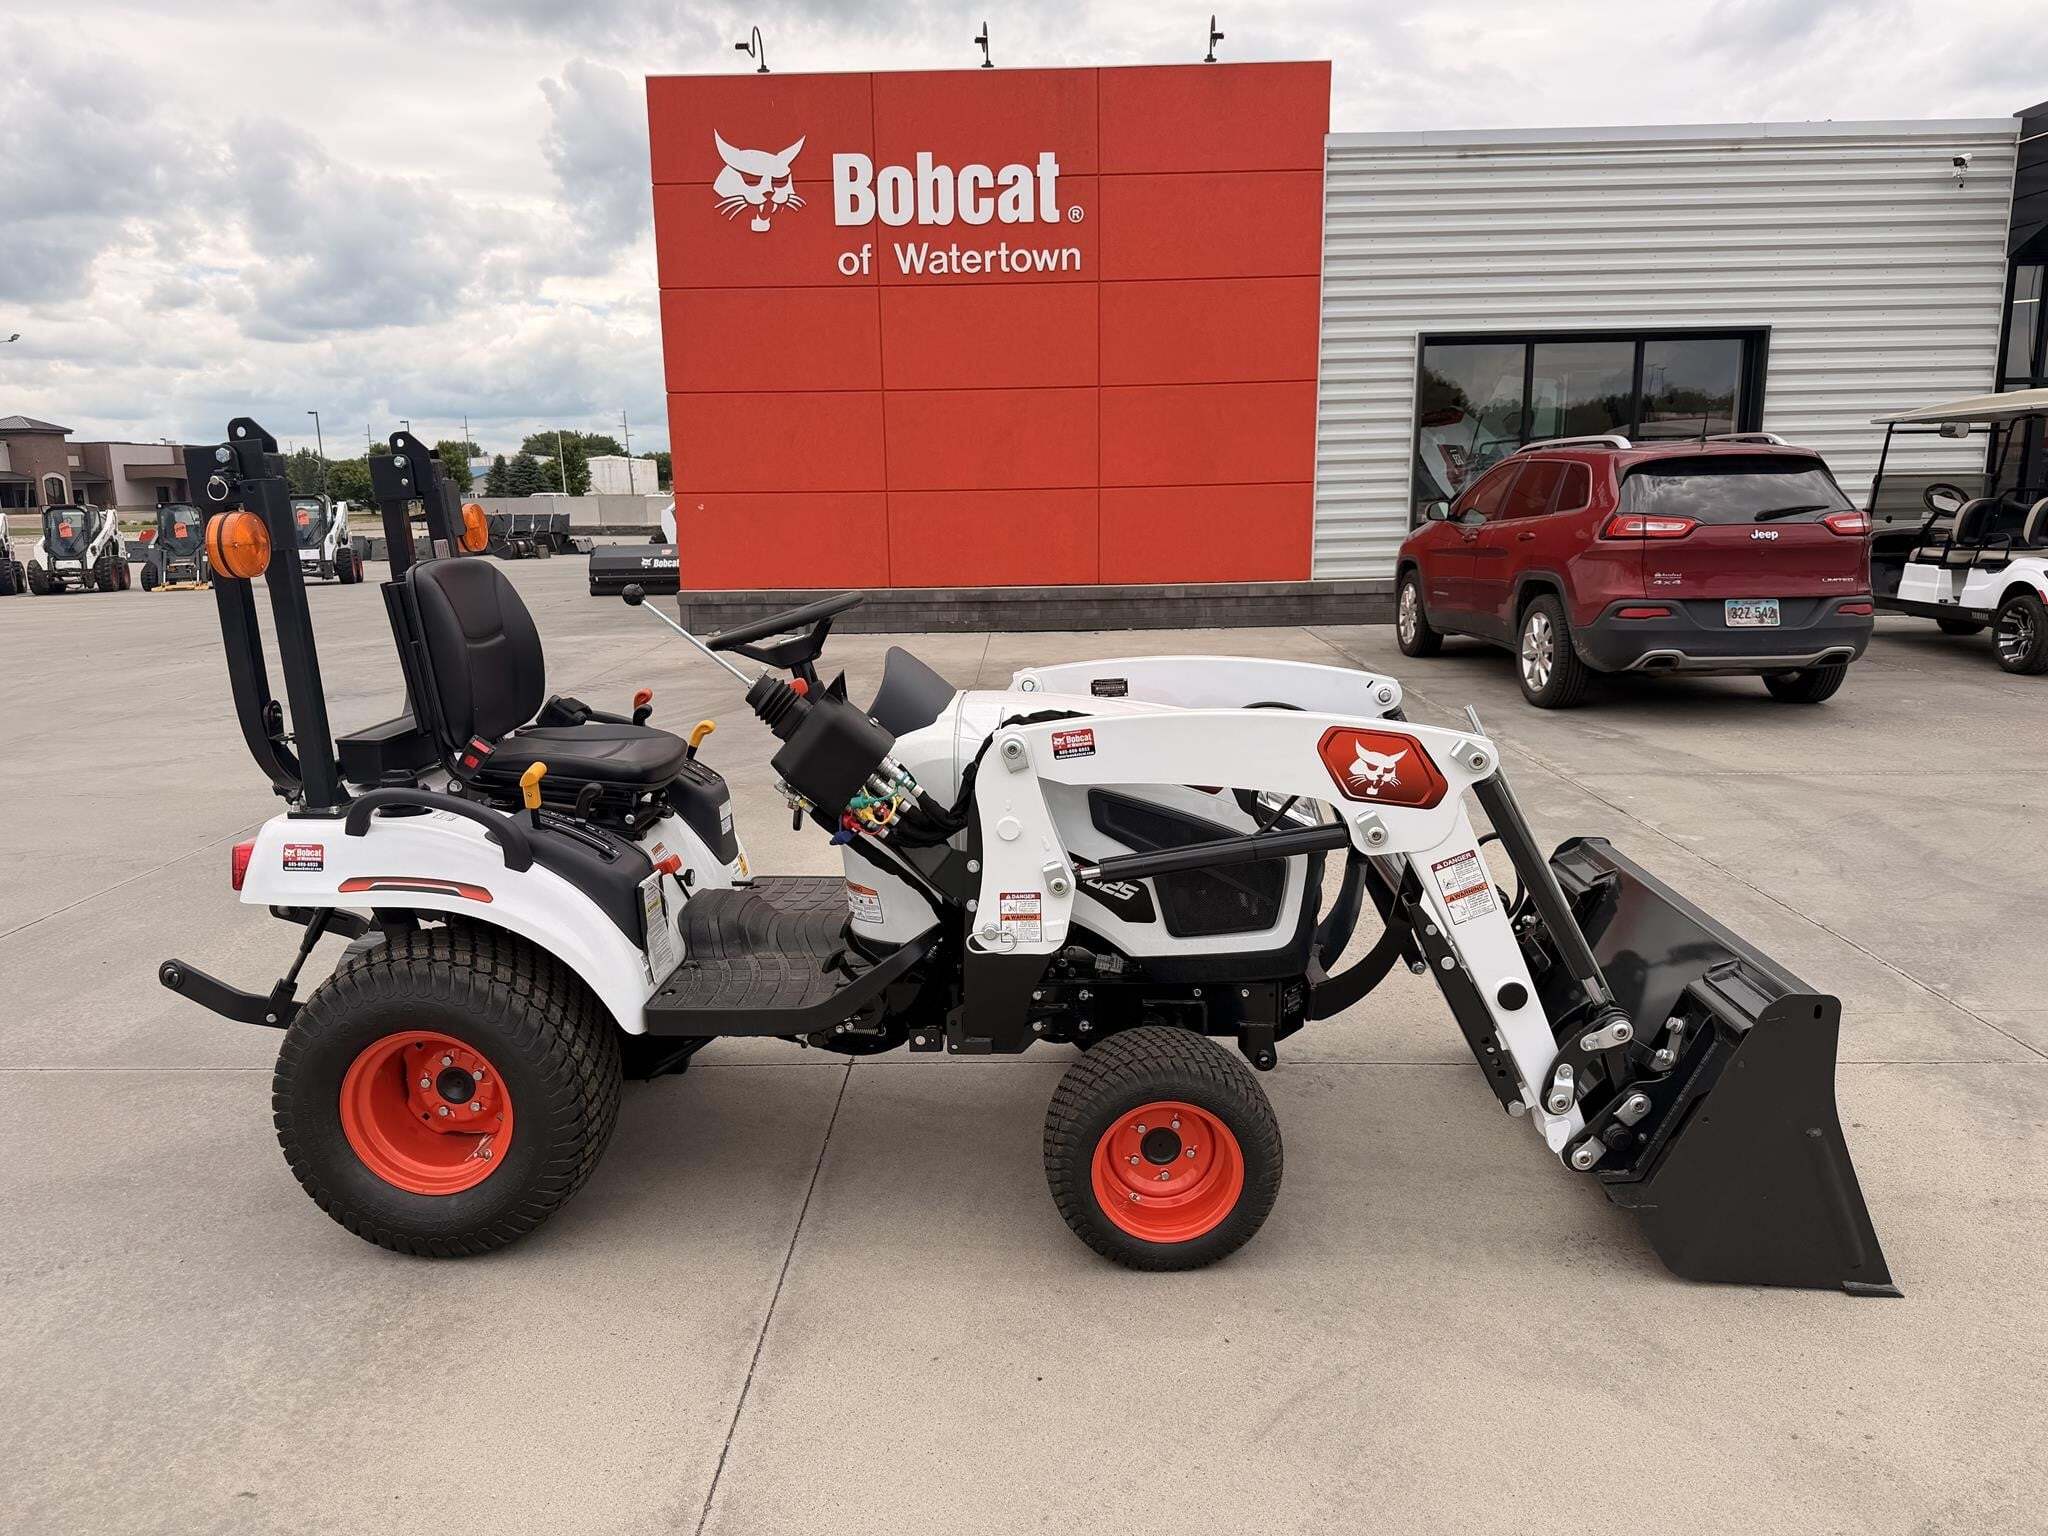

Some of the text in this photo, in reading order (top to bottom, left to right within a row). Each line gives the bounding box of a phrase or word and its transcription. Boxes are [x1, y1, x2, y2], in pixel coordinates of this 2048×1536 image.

[832, 151, 1060, 226] Bobcat
[838, 241, 1082, 276] of Watertown
[1750, 529, 1779, 540] Jeep
[1066, 733, 1092, 744] Bobcat
[296, 848, 322, 857] Bobcat
[1443, 852, 1472, 867] DANGER
[1454, 884, 1484, 900] WARNING
